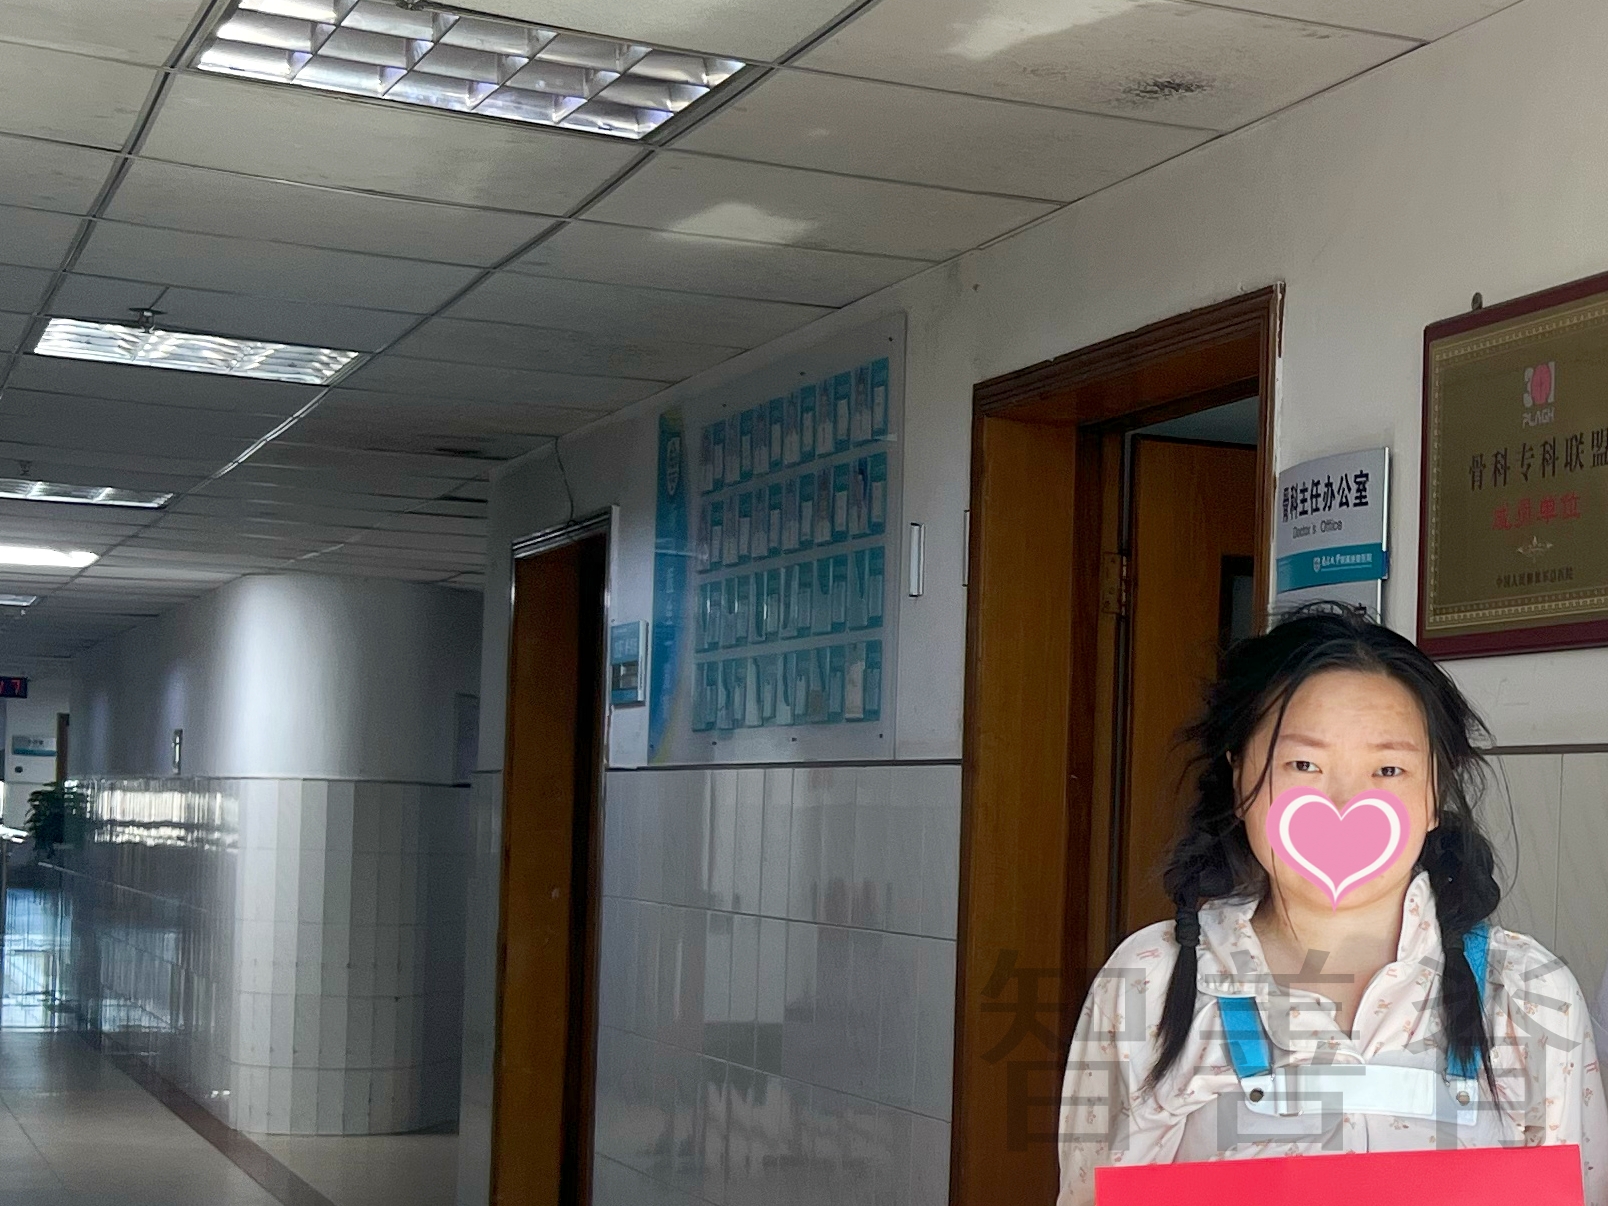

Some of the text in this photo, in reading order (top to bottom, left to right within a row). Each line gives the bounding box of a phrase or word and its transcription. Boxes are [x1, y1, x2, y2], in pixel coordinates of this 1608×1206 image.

[1523, 407, 1556, 428] PLAGH
[1282, 470, 1370, 523] 骨科主任办公室
[1320, 520, 1342, 533] Office
